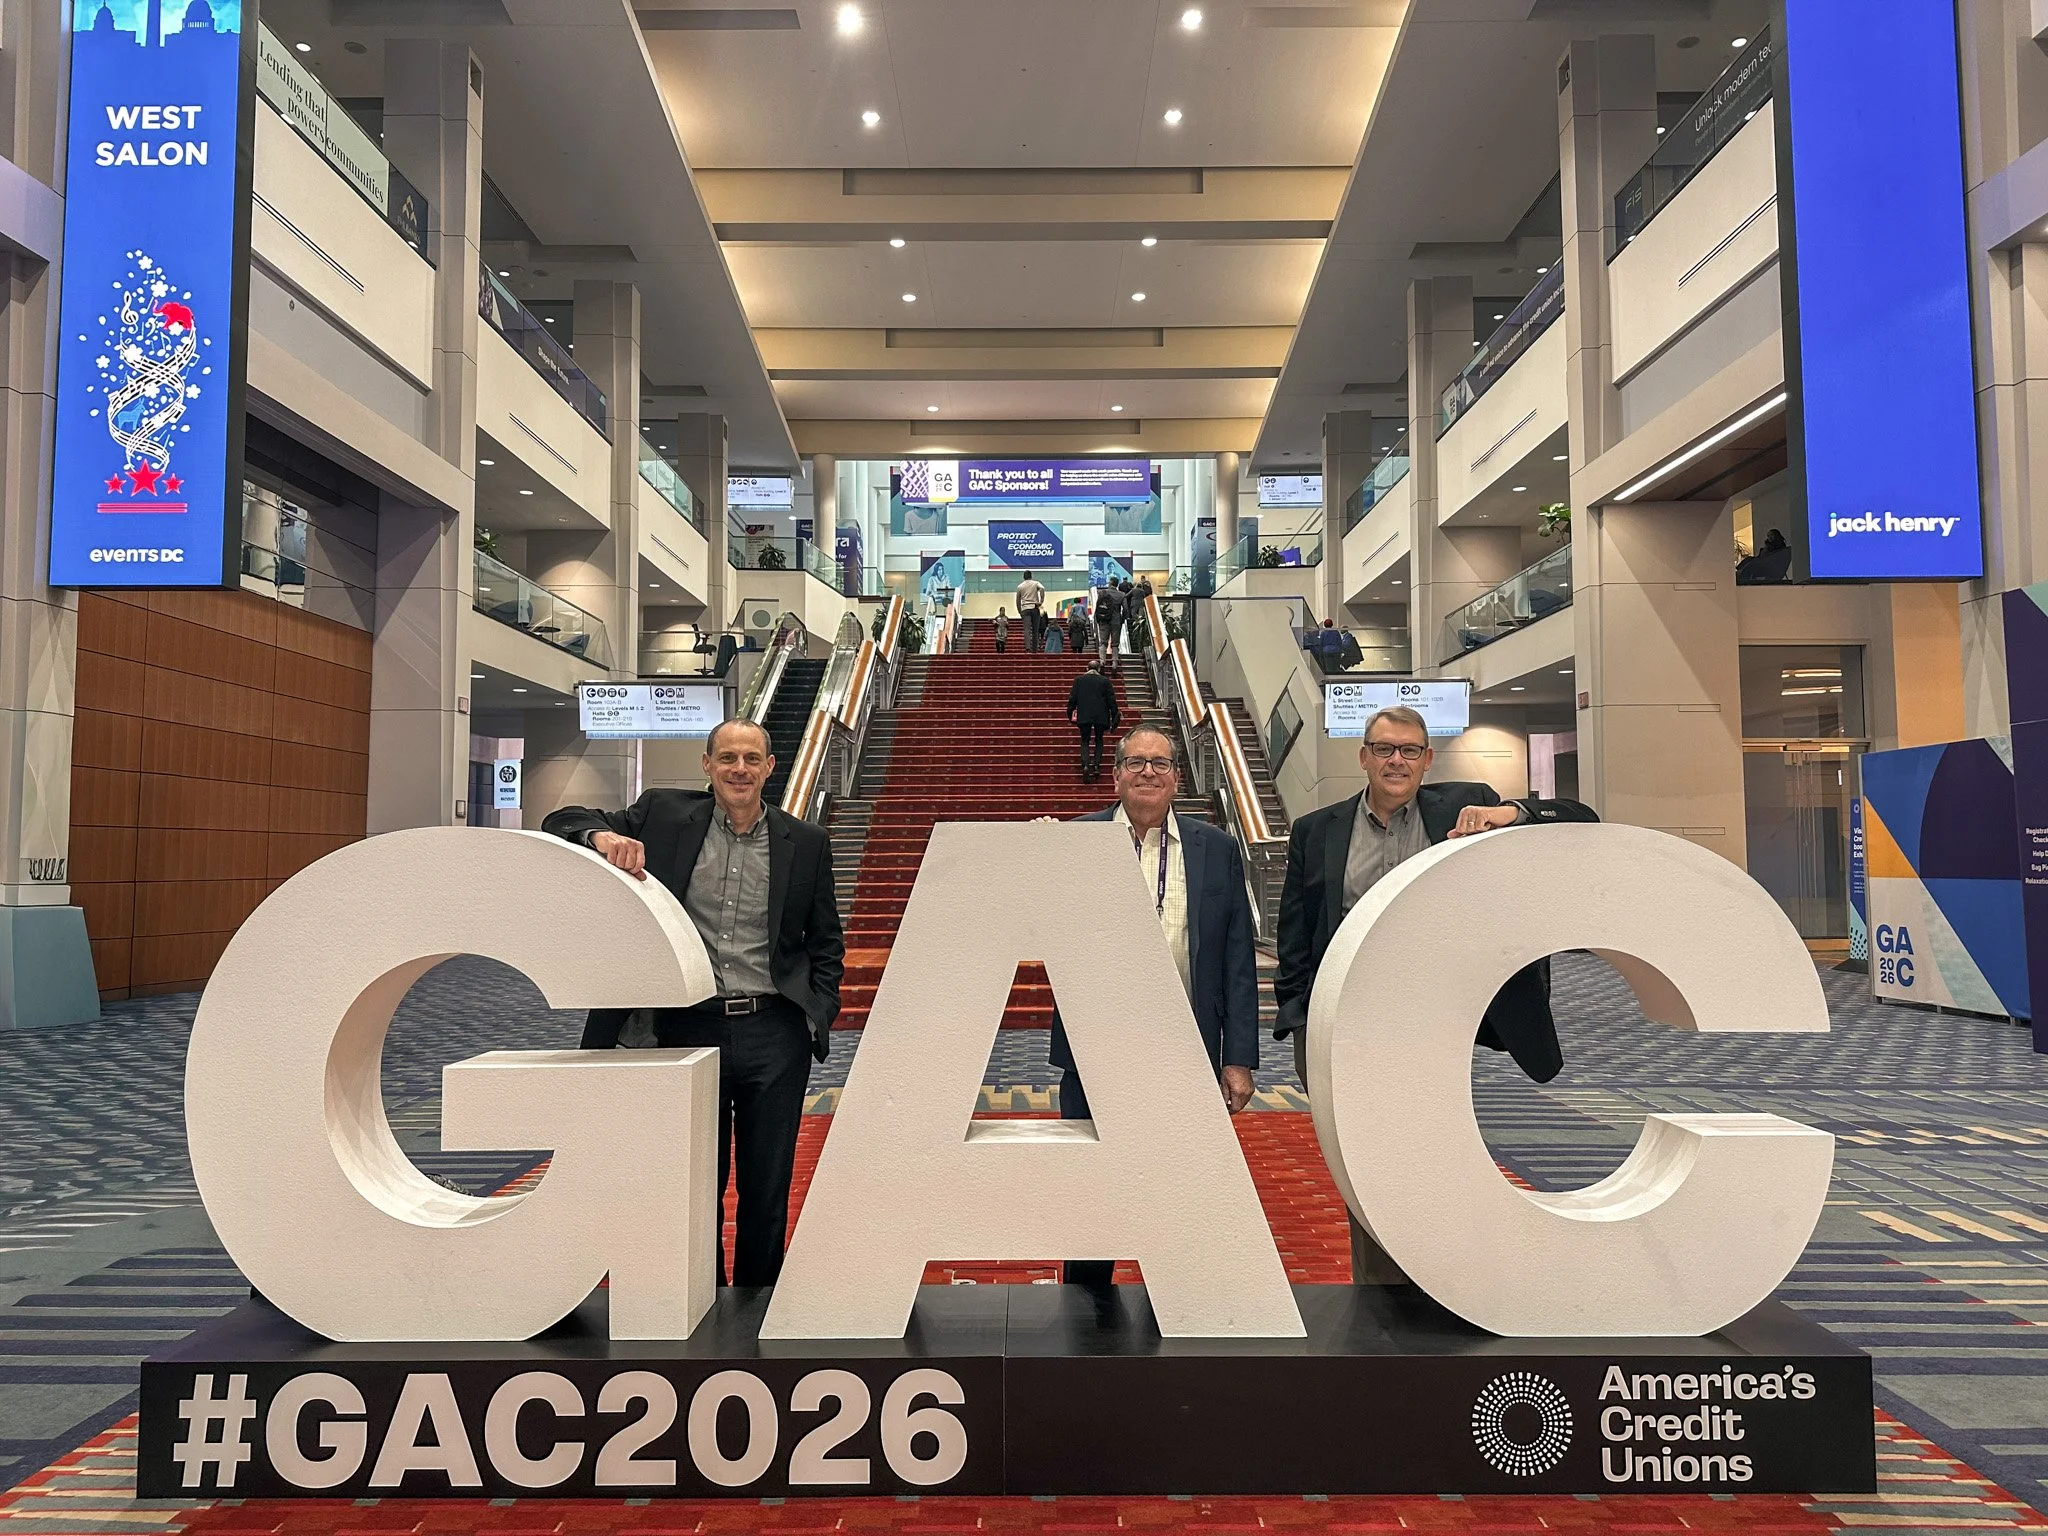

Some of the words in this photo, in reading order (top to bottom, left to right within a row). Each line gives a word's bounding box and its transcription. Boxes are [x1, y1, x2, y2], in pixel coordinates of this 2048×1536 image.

[260, 40, 304, 103] Lending
[304, 89, 326, 123] that
[1695, 94, 1723, 132] Unlock
[1724, 58, 1758, 101] modern
[105, 104, 202, 130] WEST
[95, 141, 208, 167] SALON
[287, 97, 326, 144] powers
[326, 136, 385, 204] communities
[968, 468, 1003, 480] Thank
[1005, 470, 1025, 481] you
[1027, 469, 1037, 479] to
[1040, 468, 1054, 480] all
[968, 480, 993, 491] GAC
[995, 479, 1049, 492] Sponsors!
[997, 532, 1038, 540] PROTECT
[1828, 511, 1882, 538] jack
[1876, 924, 1914, 955] GA
[1880, 957, 1894, 971] 20
[1880, 971, 1895, 984] 26
[1896, 957, 1915, 987] C
[185, 821, 1835, 1343] GAC
[1598, 1364, 1817, 1401] America’s
[172, 1368, 969, 1490] #GAC2026
[1600, 1405, 1746, 1442] Credit
[1601, 1446, 1754, 1483] Unions
